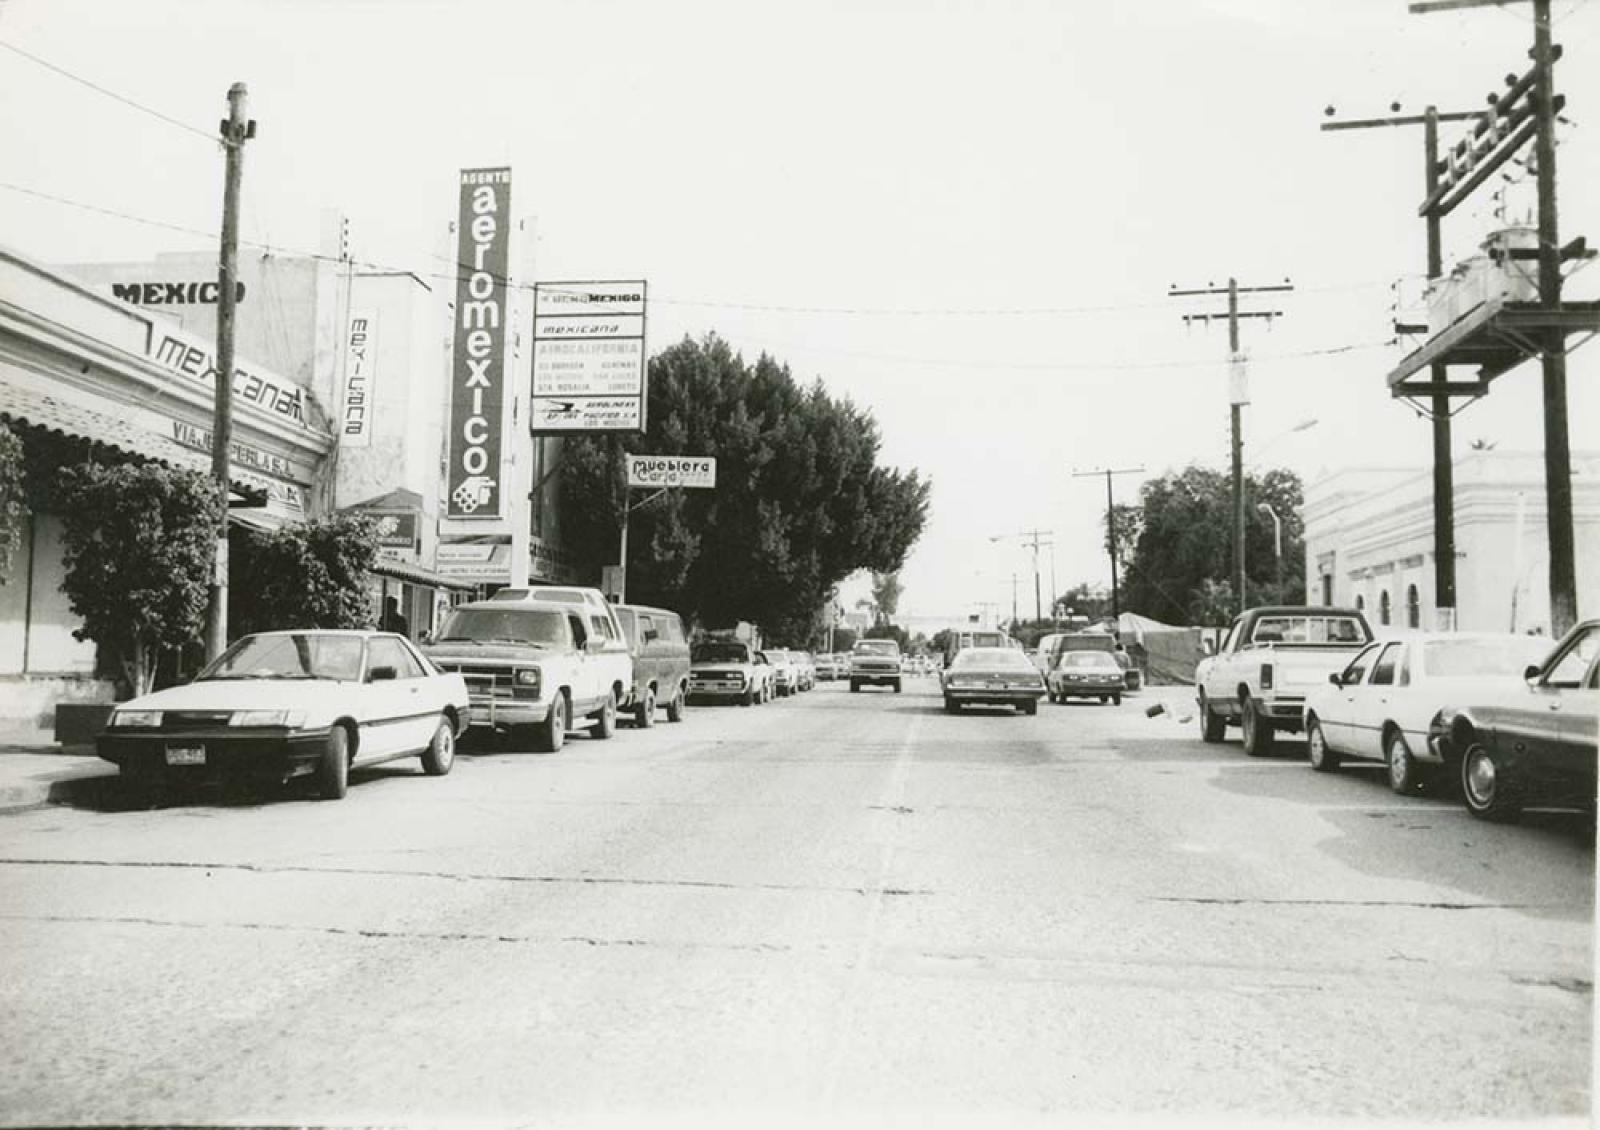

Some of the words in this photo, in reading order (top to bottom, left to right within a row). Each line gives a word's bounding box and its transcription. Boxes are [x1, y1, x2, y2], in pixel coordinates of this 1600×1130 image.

[155, 335, 293, 416] mexcana
[345, 318, 368, 435] mexicana
[462, 185, 499, 474] aeromexico
[633, 460, 710, 474] Mueblera
